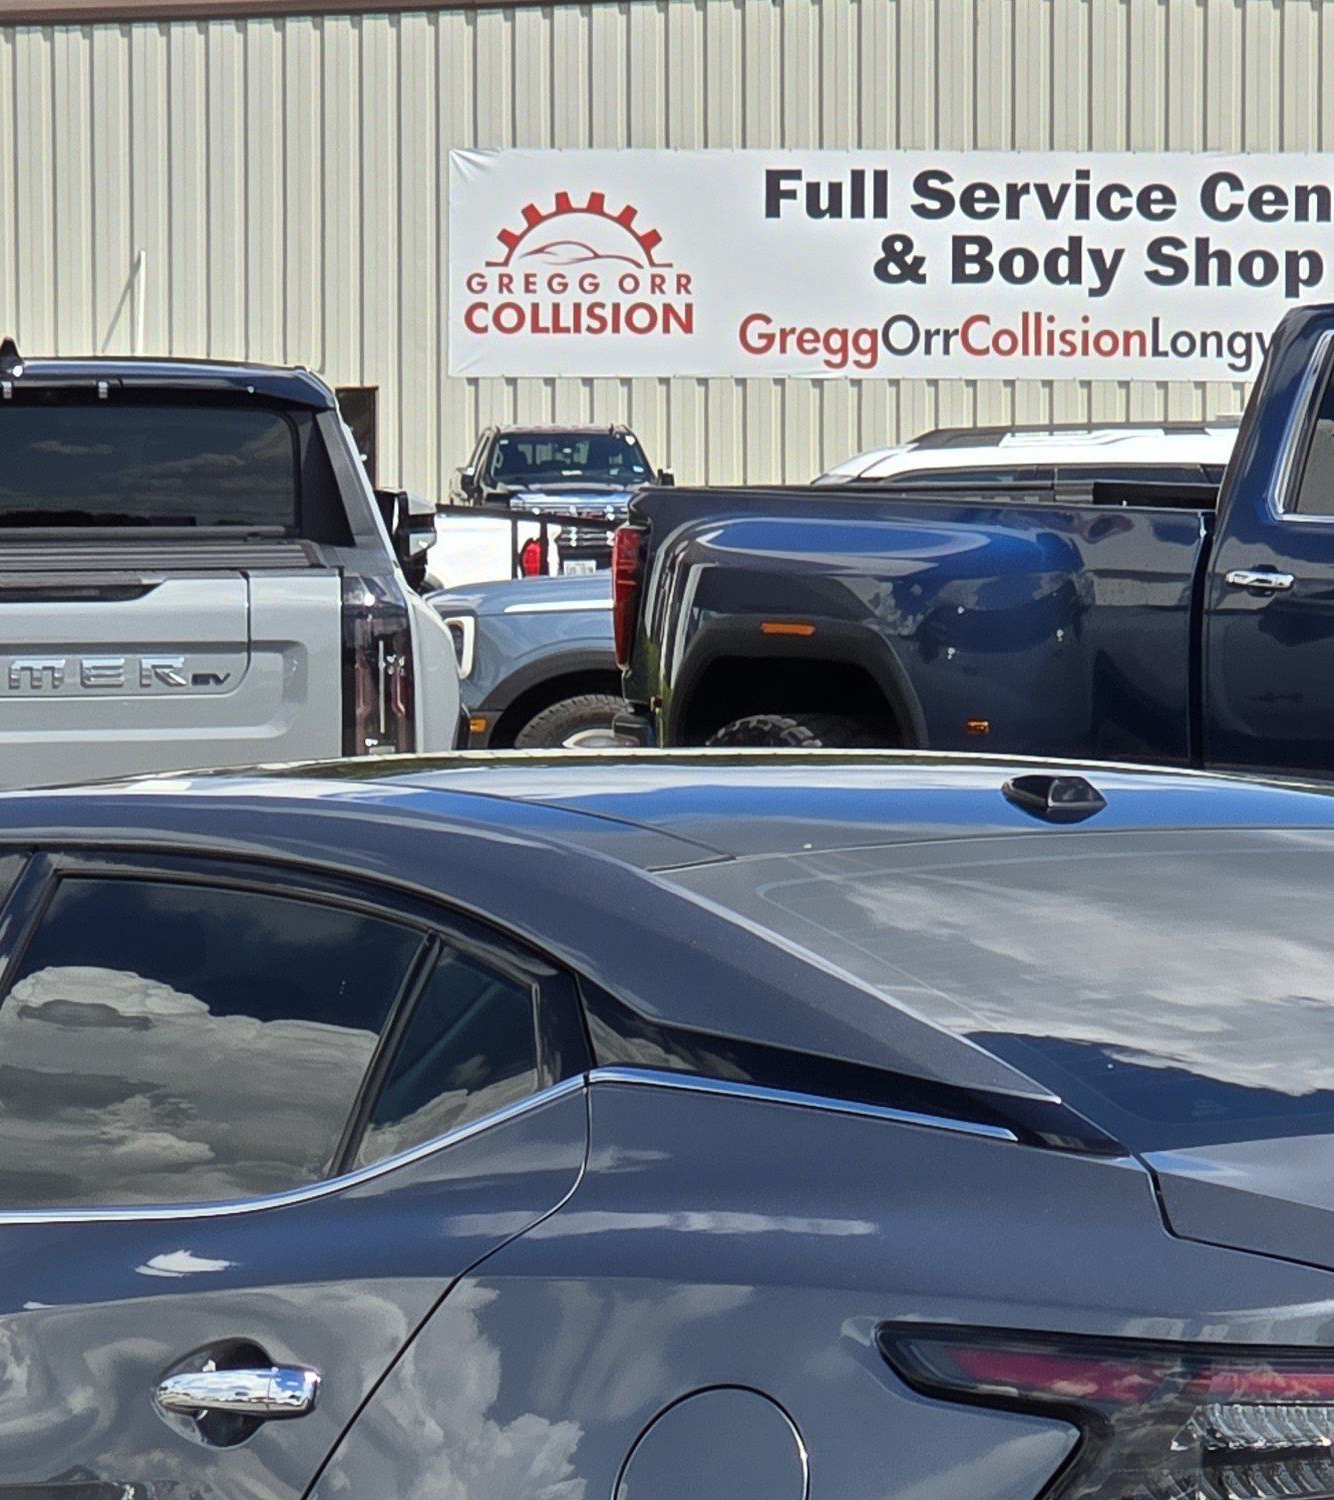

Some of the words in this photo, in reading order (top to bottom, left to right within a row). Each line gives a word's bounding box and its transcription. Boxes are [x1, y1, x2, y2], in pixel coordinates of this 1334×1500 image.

[765, 169, 888, 219] Full
[910, 169, 1177, 222] Service
[873, 233, 927, 285] &
[951, 235, 1125, 297] Body
[1144, 236, 1324, 298] Shop
[466, 272, 600, 295] GREGG
[618, 272, 692, 295] ORR
[464, 301, 694, 335] COLLISION
[191, 672, 231, 686] EV
